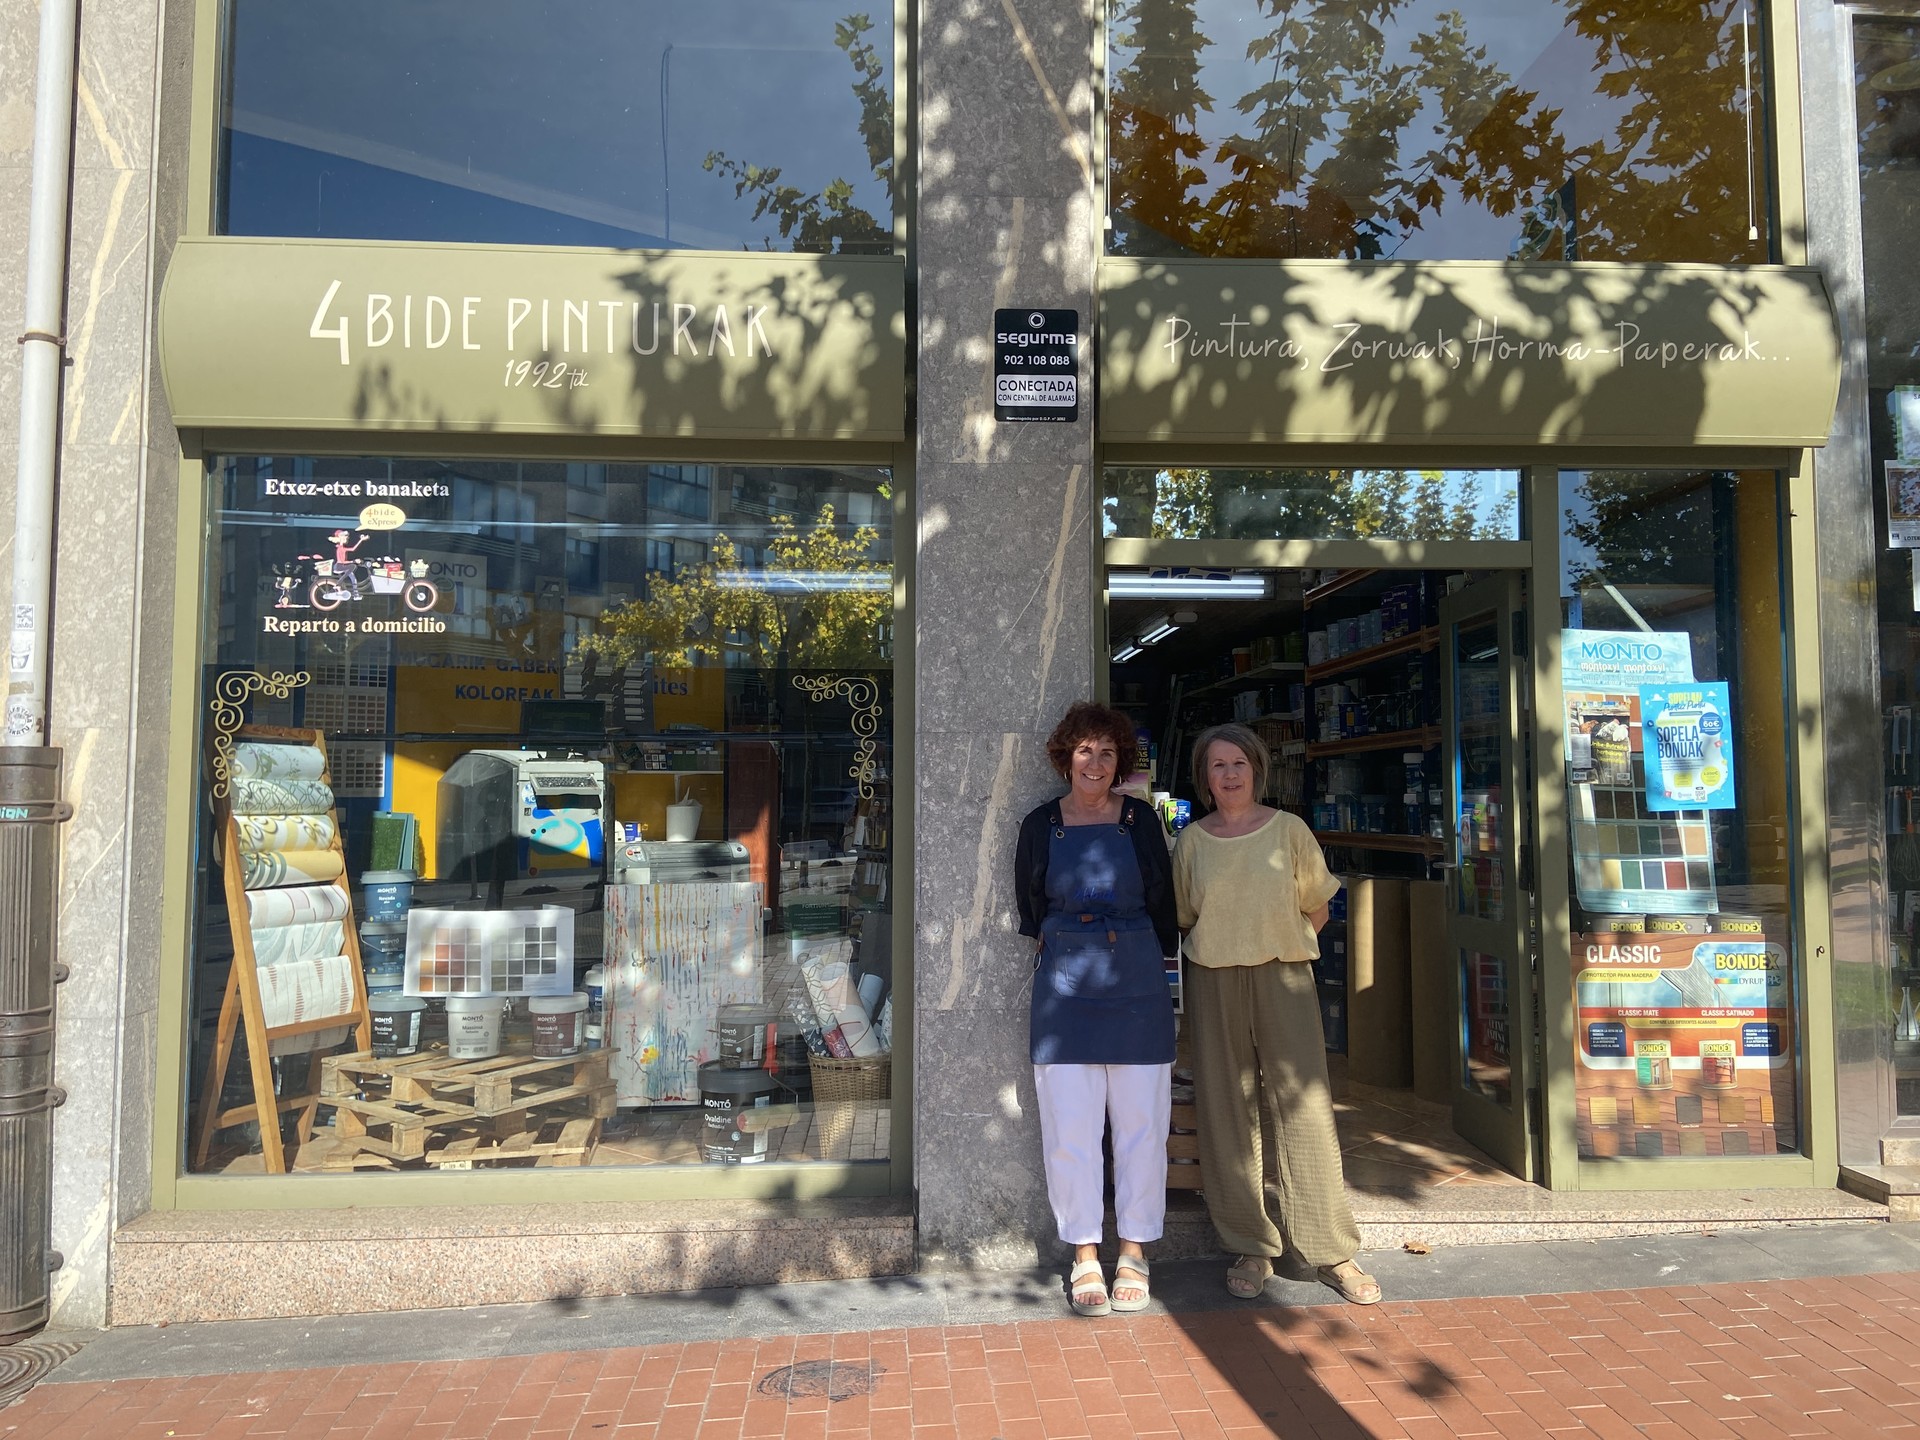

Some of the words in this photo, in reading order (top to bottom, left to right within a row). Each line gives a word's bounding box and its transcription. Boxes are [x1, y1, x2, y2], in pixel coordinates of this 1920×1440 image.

[309, 280, 350, 364] 4
[366, 294, 482, 350] BIDE
[507, 297, 772, 358] PINTURAK
[997, 333, 1077, 347] segurma
[1004, 355, 1024, 365] 902
[1028, 355, 1047, 365] 108
[1050, 356, 1070, 365] 088
[998, 380, 1075, 392] CONECTADA
[1013, 394, 1037, 402] CENTRAL
[265, 479, 360, 497] Etxez-etxe
[366, 480, 450, 498] banaketa
[430, 562, 477, 578] ONTO
[264, 617, 340, 636] Reparto
[345, 621, 356, 633] a
[361, 617, 446, 633] domicilio
[1581, 642, 1662, 661] MONTO
[455, 685, 554, 701] KOLOREAK
[1656, 726, 1699, 742] SOPELA
[1658, 741, 1704, 758] BONUAK
[1610, 920, 1644, 932] BONDE
[1586, 945, 1661, 964] CLASSIC
[1715, 952, 1780, 971] BONDEX
[1738, 977, 1764, 985] DYRUP
[704, 1098, 731, 1109] MONTÓ
[704, 1113, 731, 1124] Ovaldine
